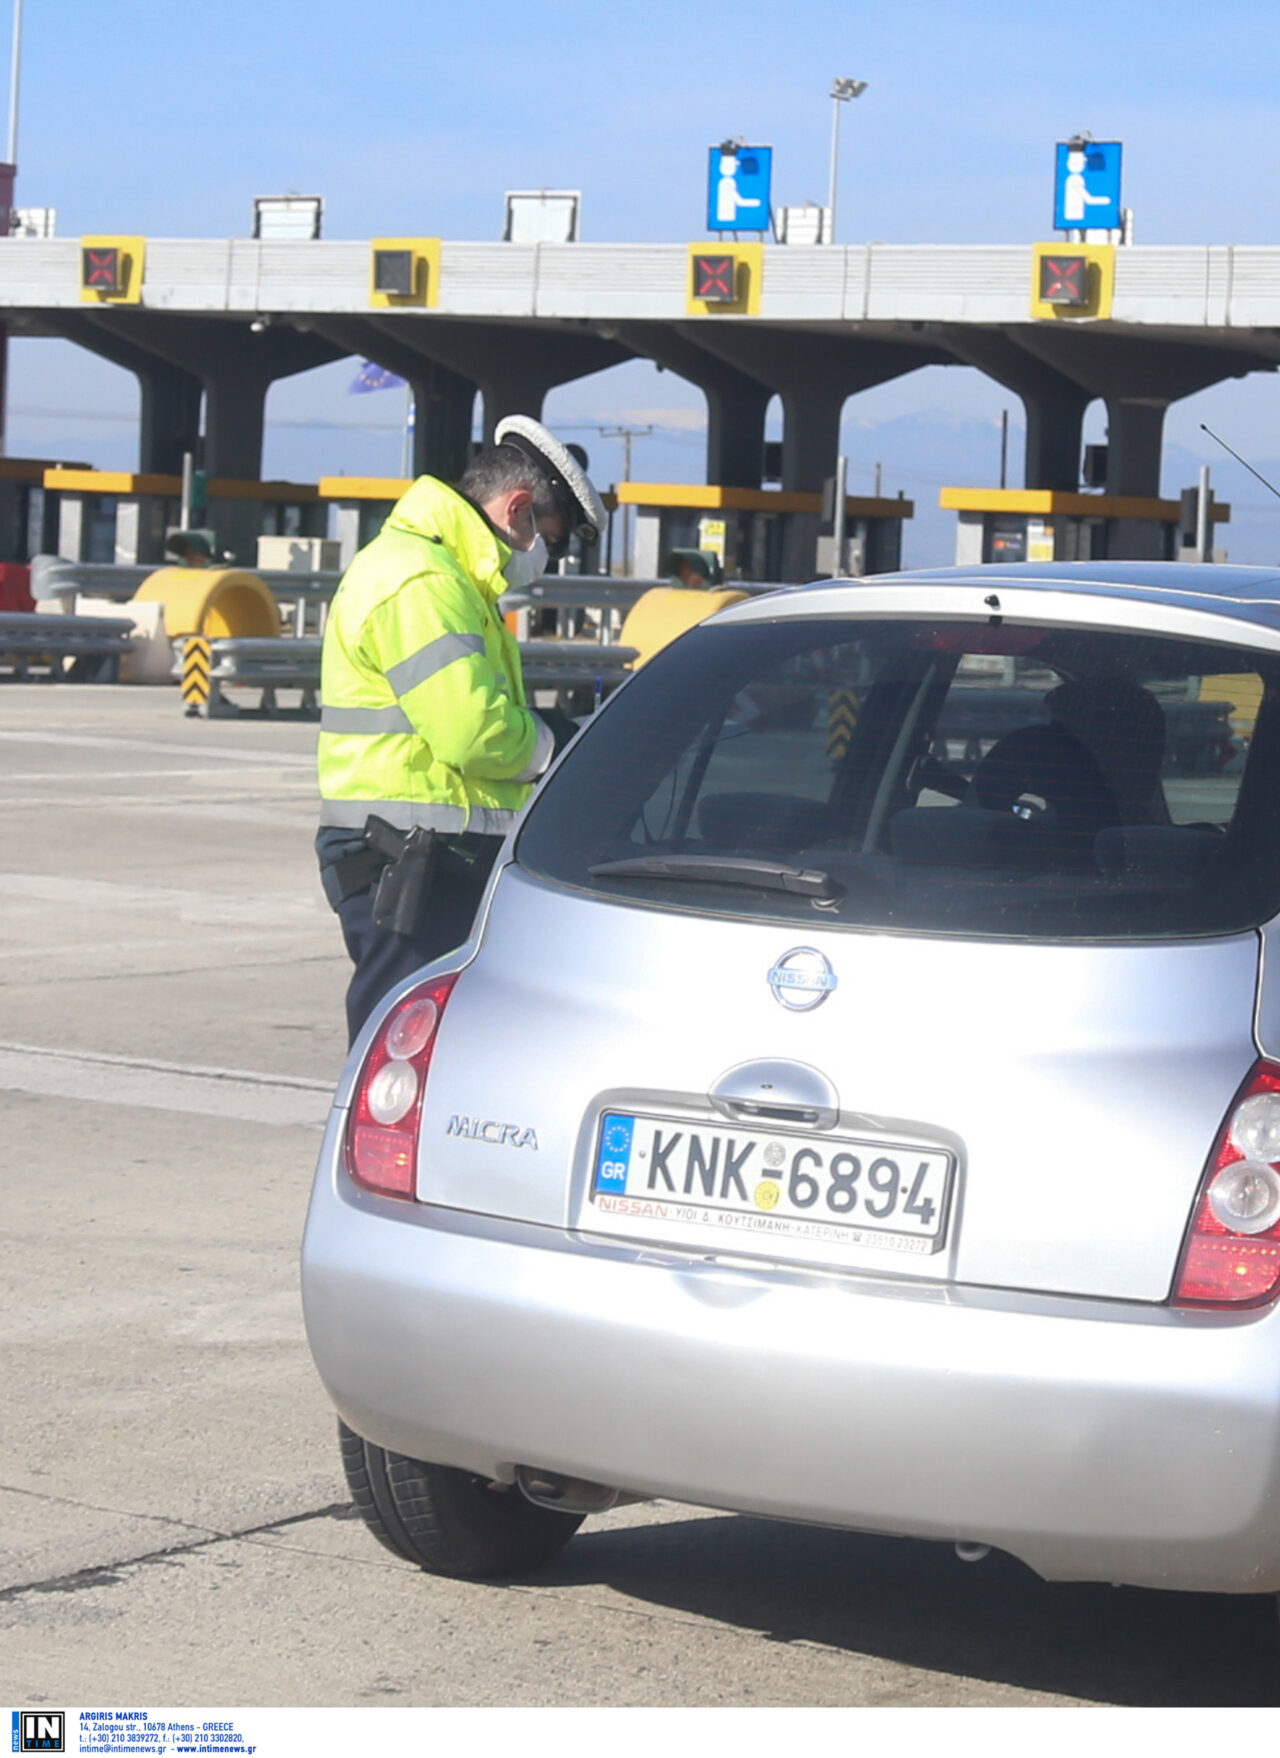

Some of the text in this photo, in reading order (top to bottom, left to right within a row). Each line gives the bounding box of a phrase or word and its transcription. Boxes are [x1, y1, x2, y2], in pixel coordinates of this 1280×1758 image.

[446, 1115, 538, 1150] MICRA
[601, 1161, 626, 1180] GR
[599, 1197, 668, 1217] NISSAN
